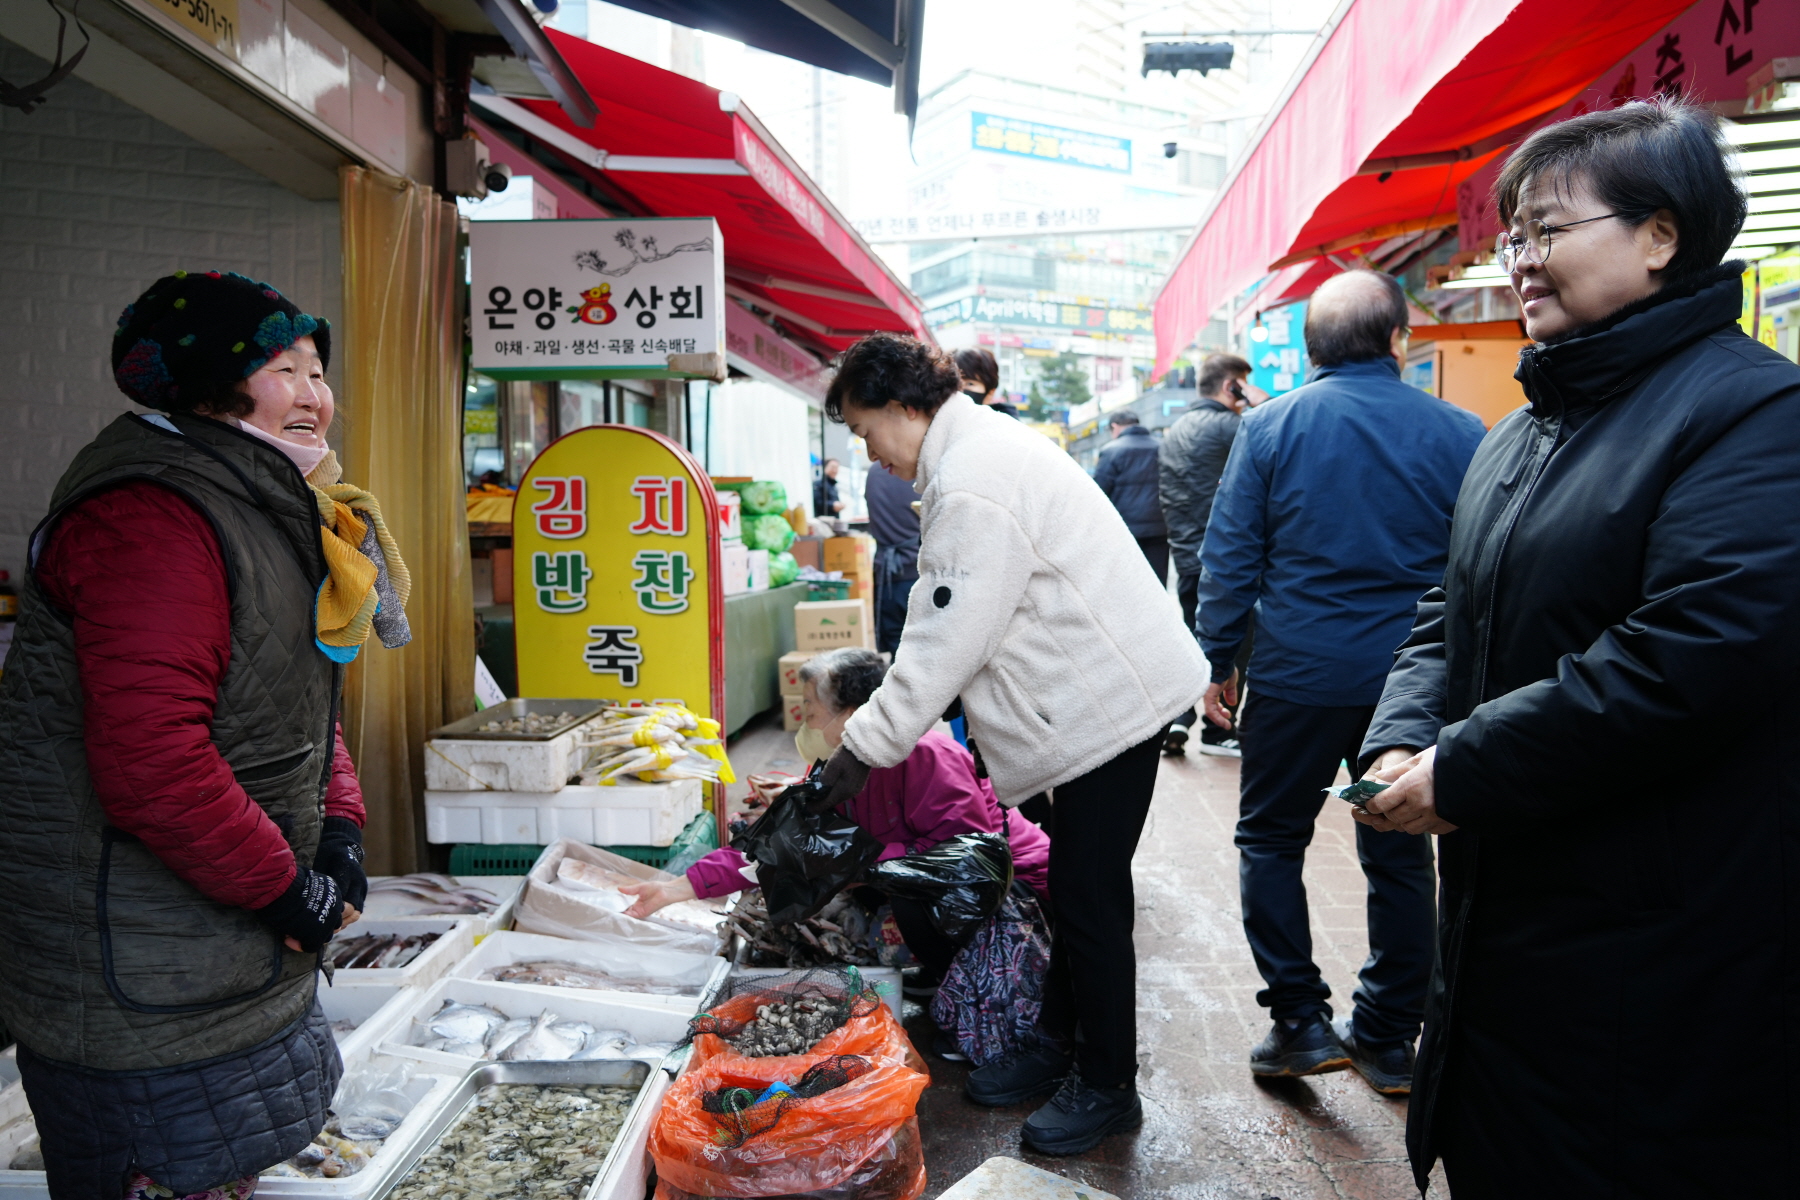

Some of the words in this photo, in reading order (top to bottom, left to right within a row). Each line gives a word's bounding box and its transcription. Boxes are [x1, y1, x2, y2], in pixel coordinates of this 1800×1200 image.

[890, 216, 918, 235] 전통
[927, 214, 974, 233] 언제나
[982, 211, 1027, 229] 푸르른
[484, 286, 562, 330] 온양
[624, 285, 703, 329] 상회
[641, 338, 697, 354] 신속배달
[583, 625, 643, 687] 죽
